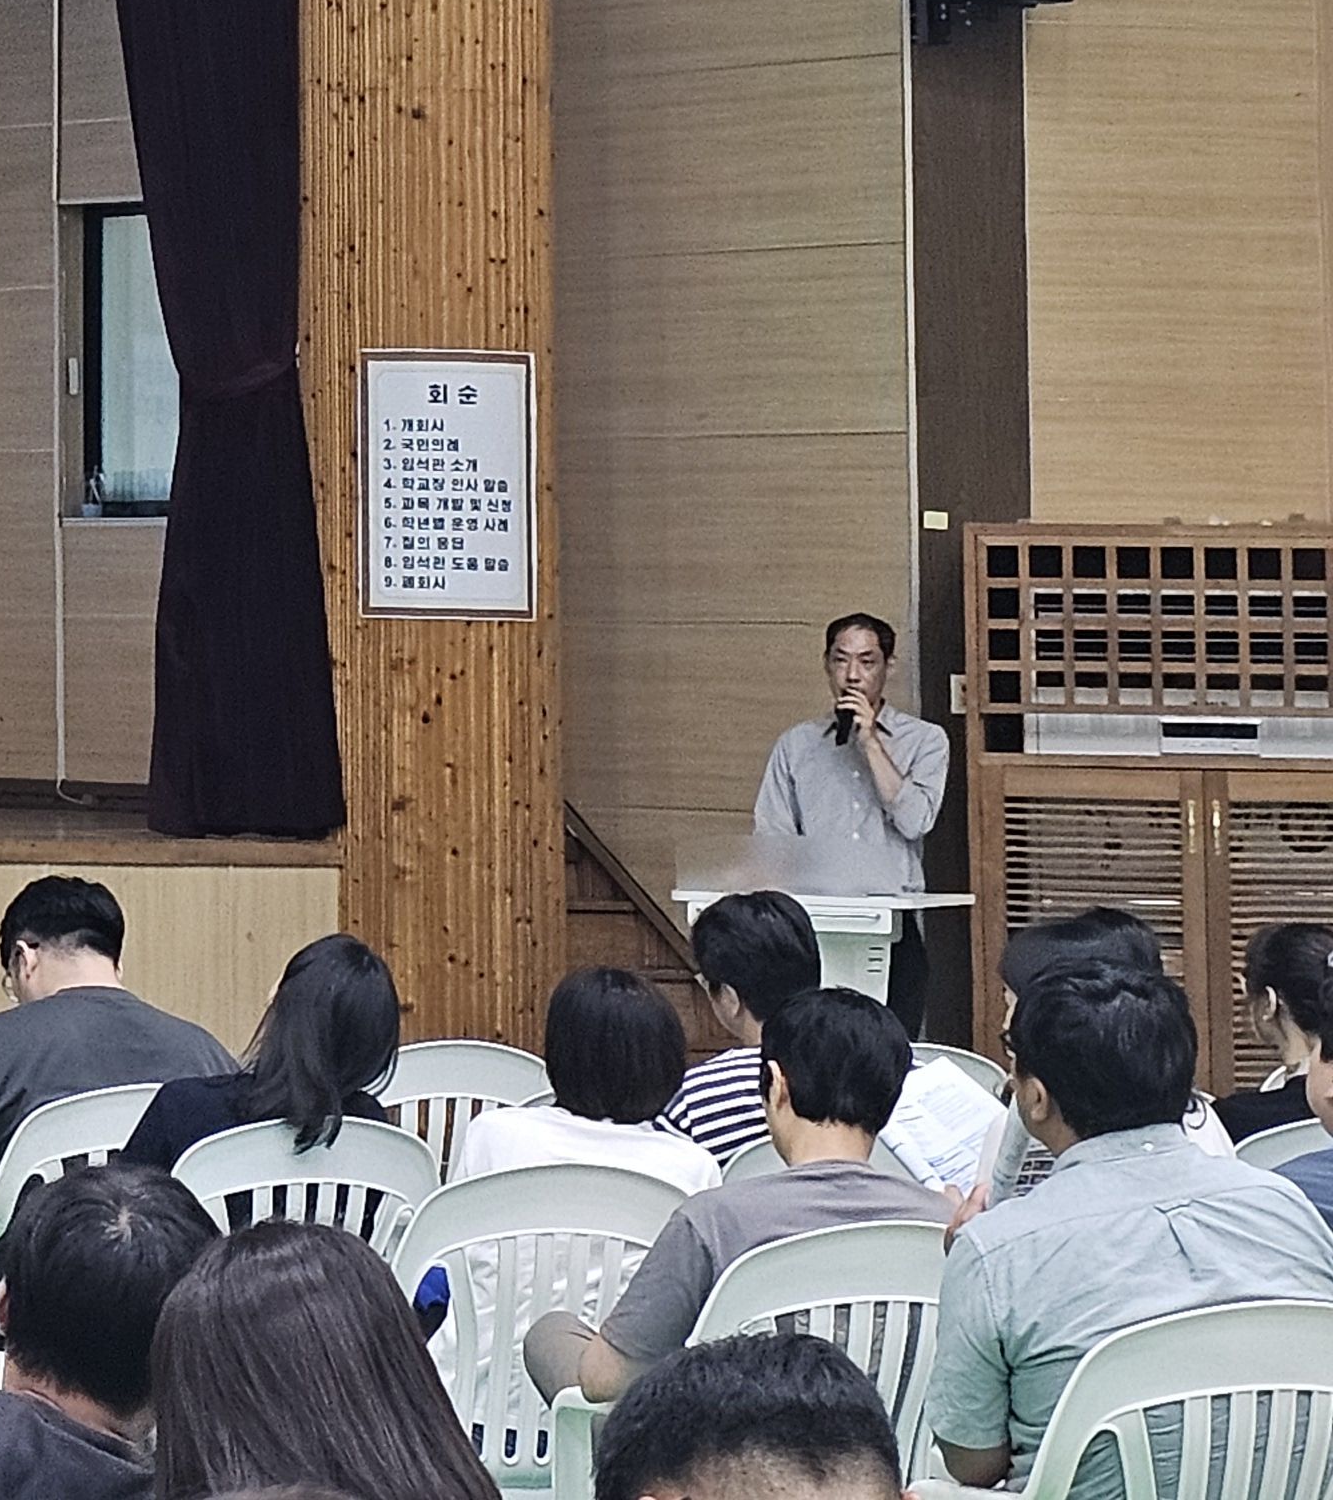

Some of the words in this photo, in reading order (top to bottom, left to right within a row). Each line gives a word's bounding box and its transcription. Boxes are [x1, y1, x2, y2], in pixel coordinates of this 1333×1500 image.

[401, 418, 444, 432] 개회사
[401, 438, 459, 452] 국민의례
[451, 459, 478, 472] 소개
[402, 478, 444, 491] 학교장
[451, 478, 478, 492] 인사
[436, 498, 464, 511] 개발
[452, 517, 478, 531] 운영
[484, 518, 508, 532] 사례
[452, 556, 478, 571] 도움
